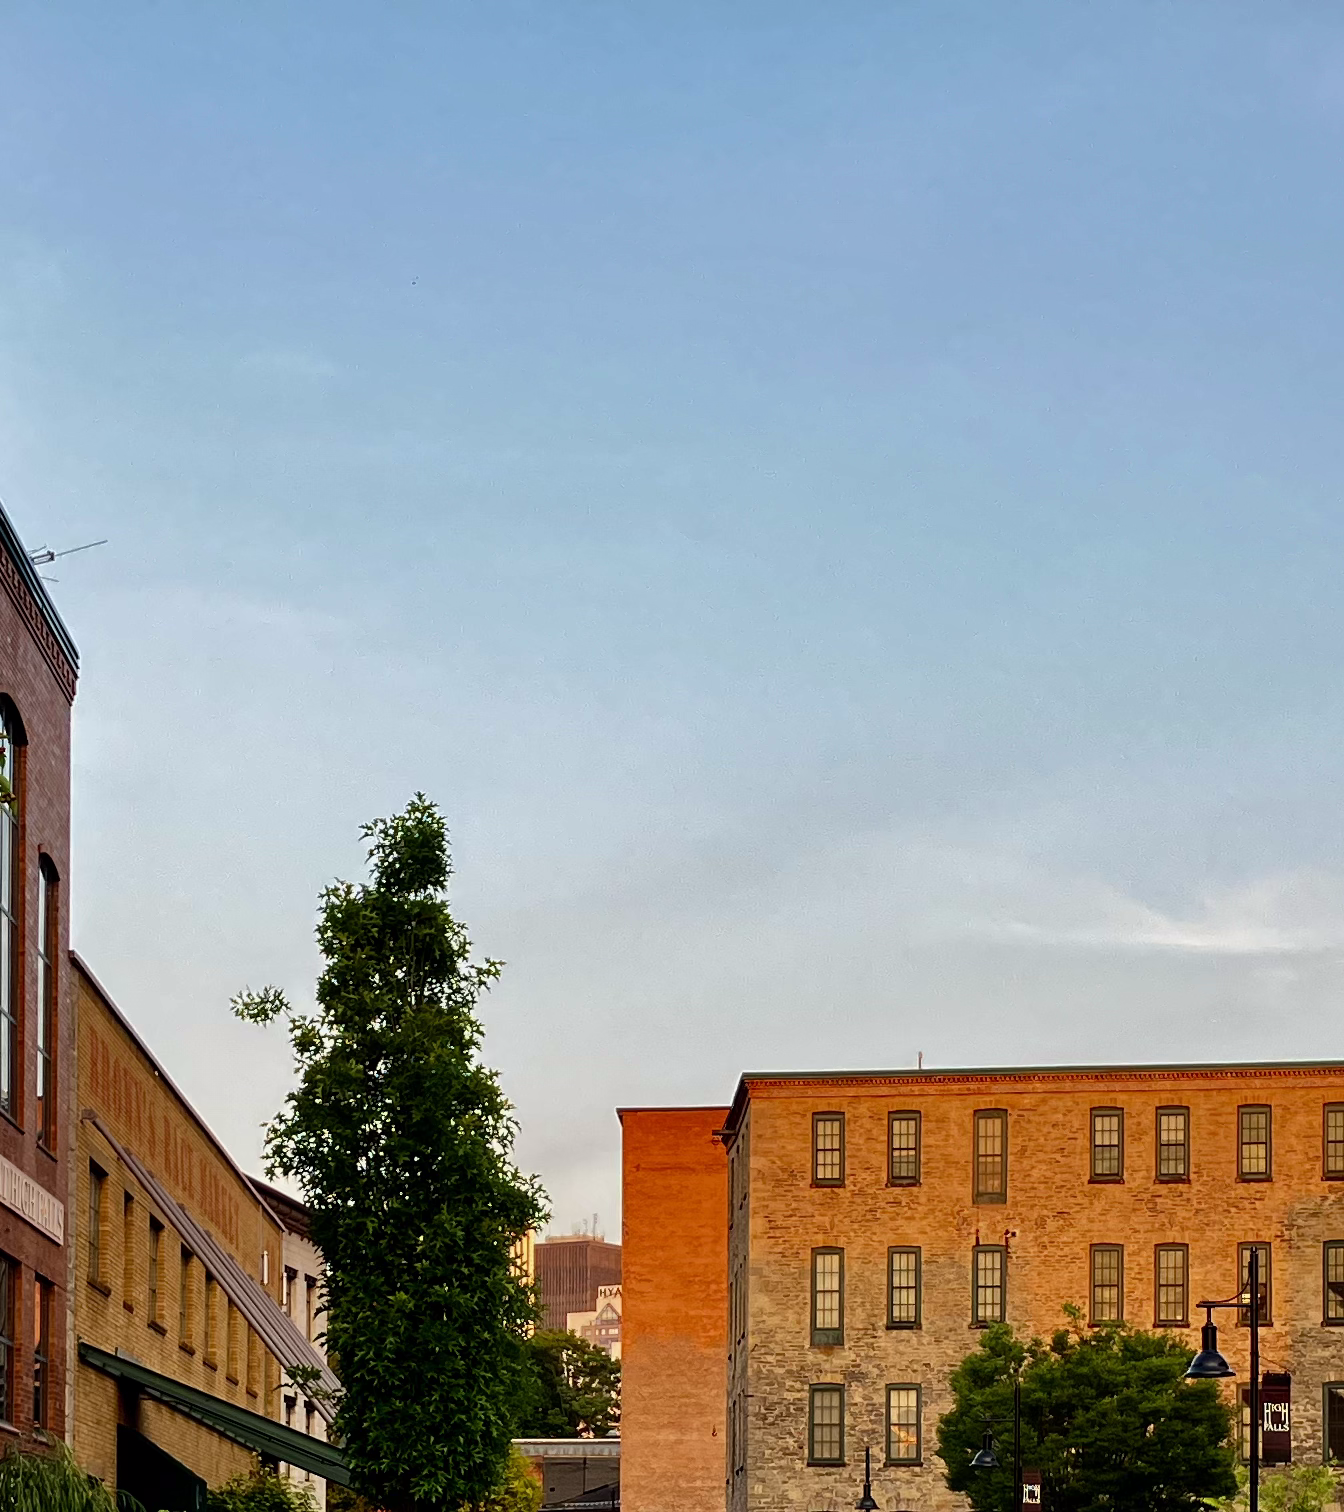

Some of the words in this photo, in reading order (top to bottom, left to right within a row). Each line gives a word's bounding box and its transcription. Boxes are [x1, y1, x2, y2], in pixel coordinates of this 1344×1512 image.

[9, 1166, 36, 1221] HIGH
[36, 1187, 64, 1241] FALLS
[1263, 1402, 1289, 1424] HIGH
[1263, 1423, 1289, 1431] FALLS
